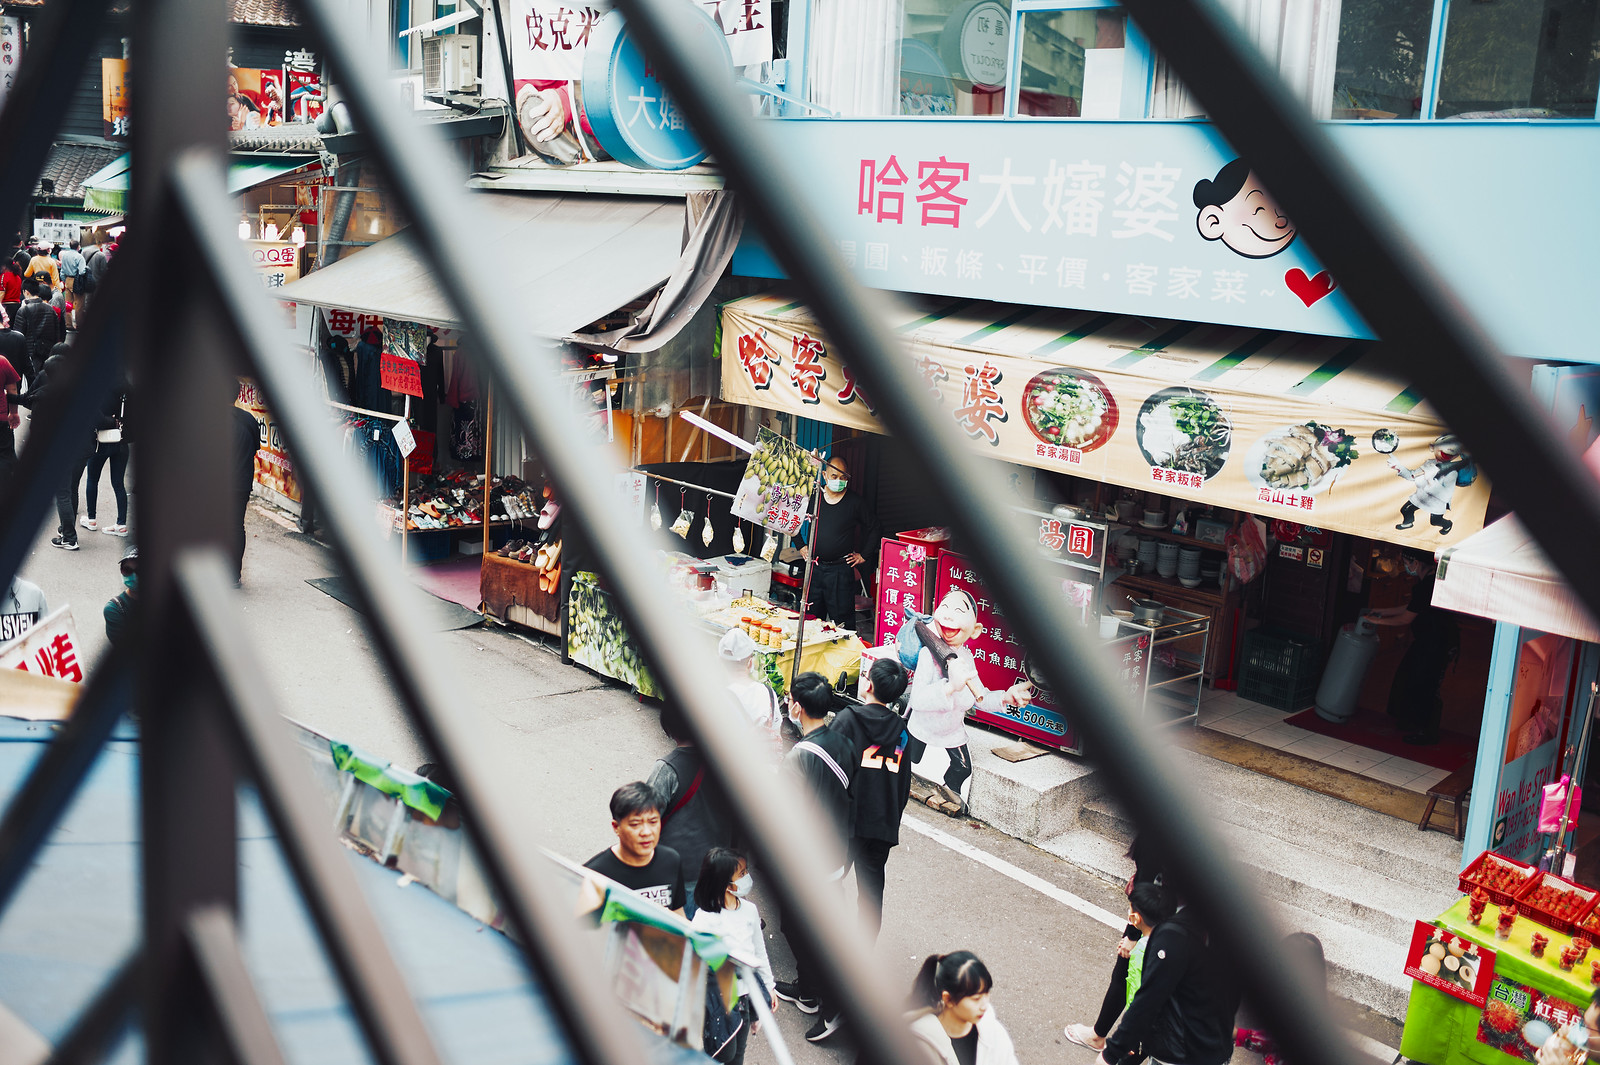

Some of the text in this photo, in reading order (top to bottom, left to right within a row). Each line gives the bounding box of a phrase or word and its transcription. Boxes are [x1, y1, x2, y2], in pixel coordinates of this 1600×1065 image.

[525, 6, 601, 51] 皮克米
[252, 247, 295, 263] QQ蛋
[1036, 443, 1083, 465] 客家湯圓
[1151, 467, 1203, 489] 客家粄條
[1257, 486, 1315, 511] 高山土雞
[1039, 518, 1095, 559] 湯圓
[14, 633, 83, 683] 烤
[1494, 983, 1528, 1010] 台灣
